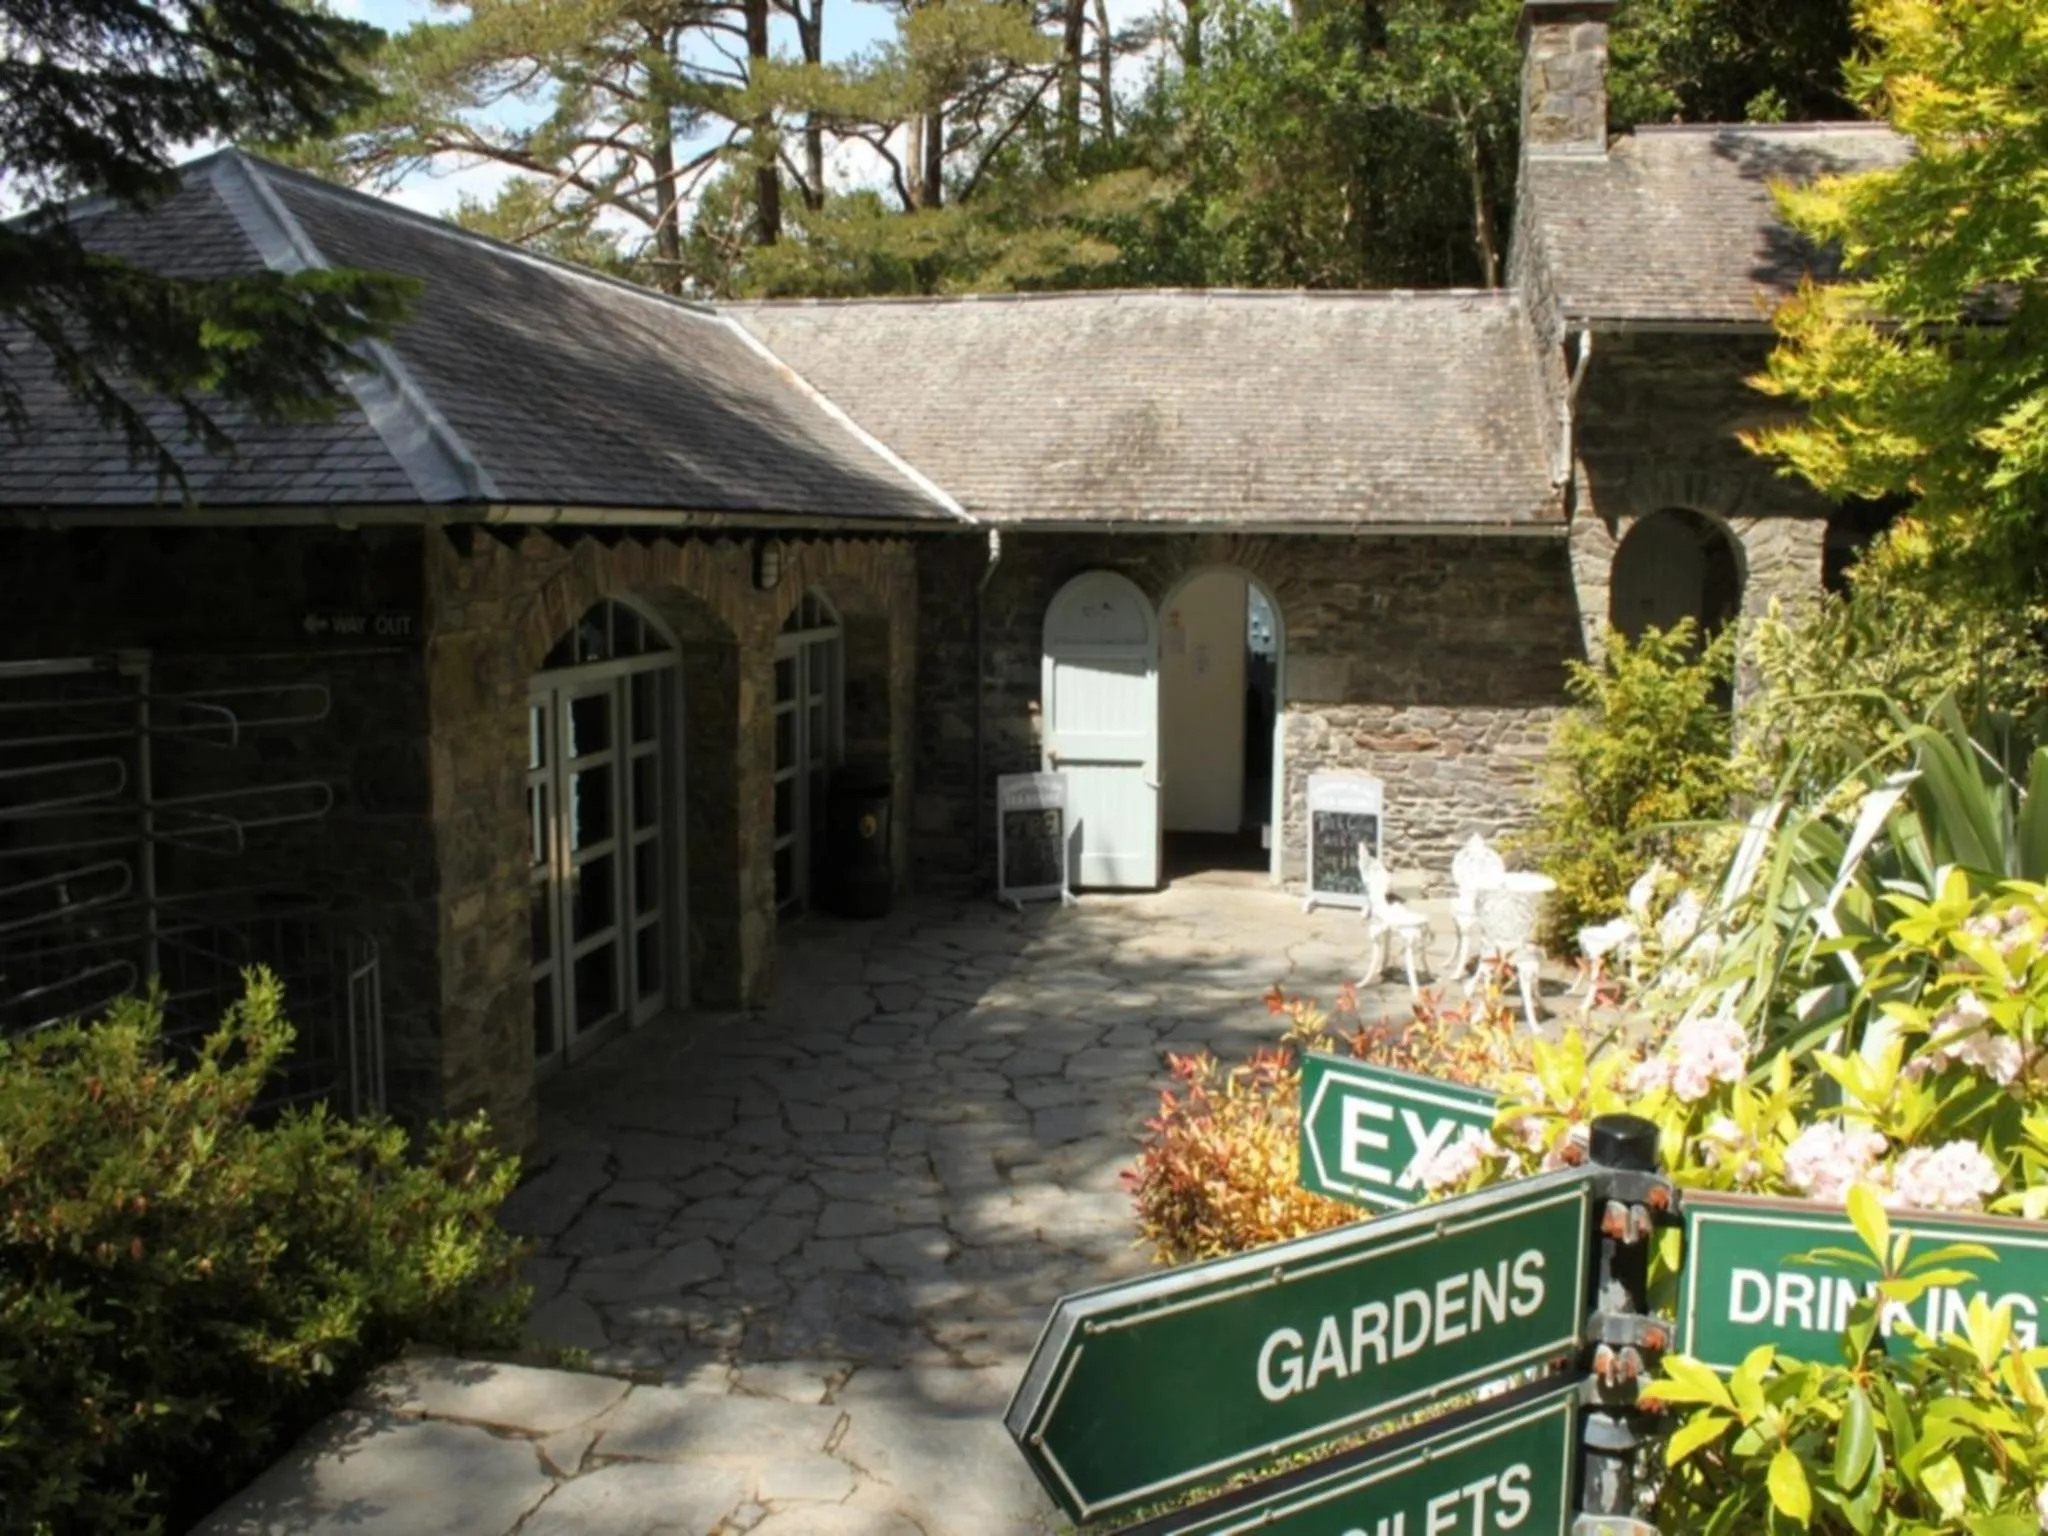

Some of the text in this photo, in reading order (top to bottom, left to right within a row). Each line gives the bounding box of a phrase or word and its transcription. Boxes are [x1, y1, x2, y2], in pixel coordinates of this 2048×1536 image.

[331, 614, 412, 635] WAY OUT
[1256, 1249, 1546, 1402] GARDENS
